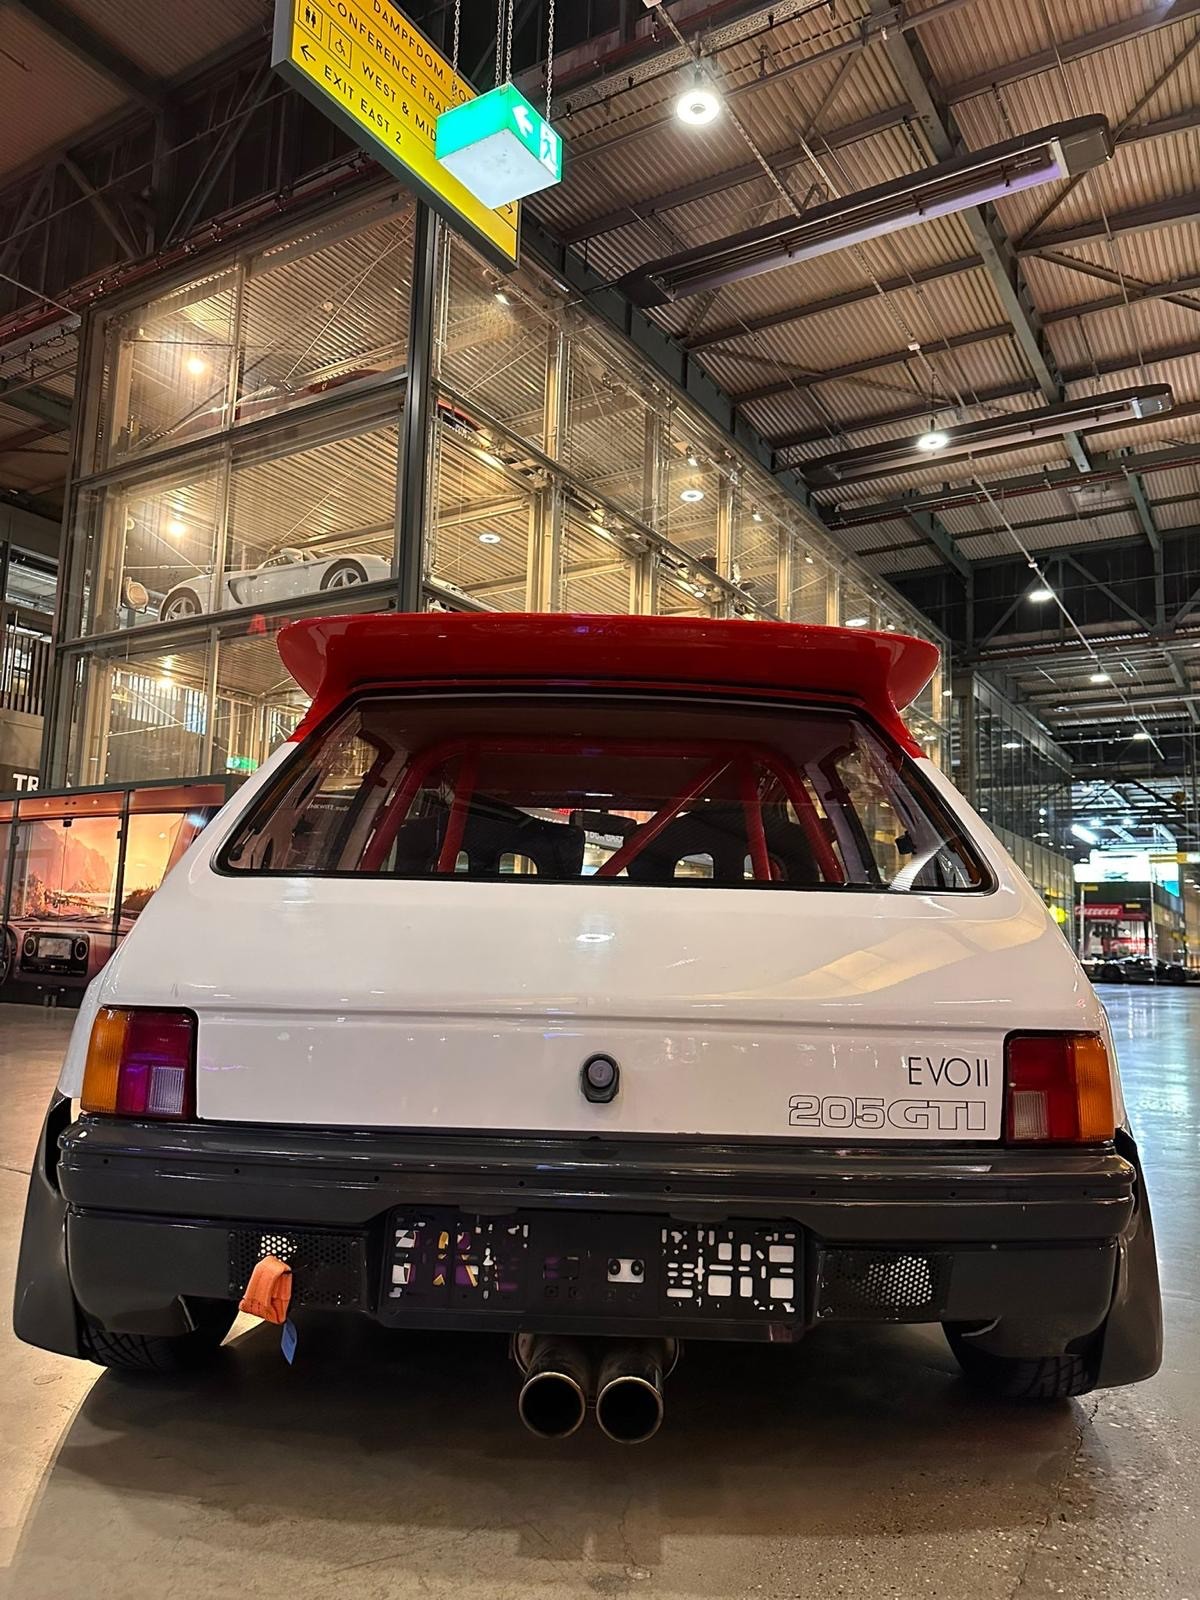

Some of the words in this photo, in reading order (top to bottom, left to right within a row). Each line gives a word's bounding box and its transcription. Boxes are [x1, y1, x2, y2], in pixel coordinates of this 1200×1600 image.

[324, 64, 354, 100] EXIT
[360, 98, 390, 133] EAST
[395, 131, 402, 145] 2
[362, 61, 396, 102] WEST
[401, 101, 410, 117] &
[788, 1094, 987, 1131] 205GTI
